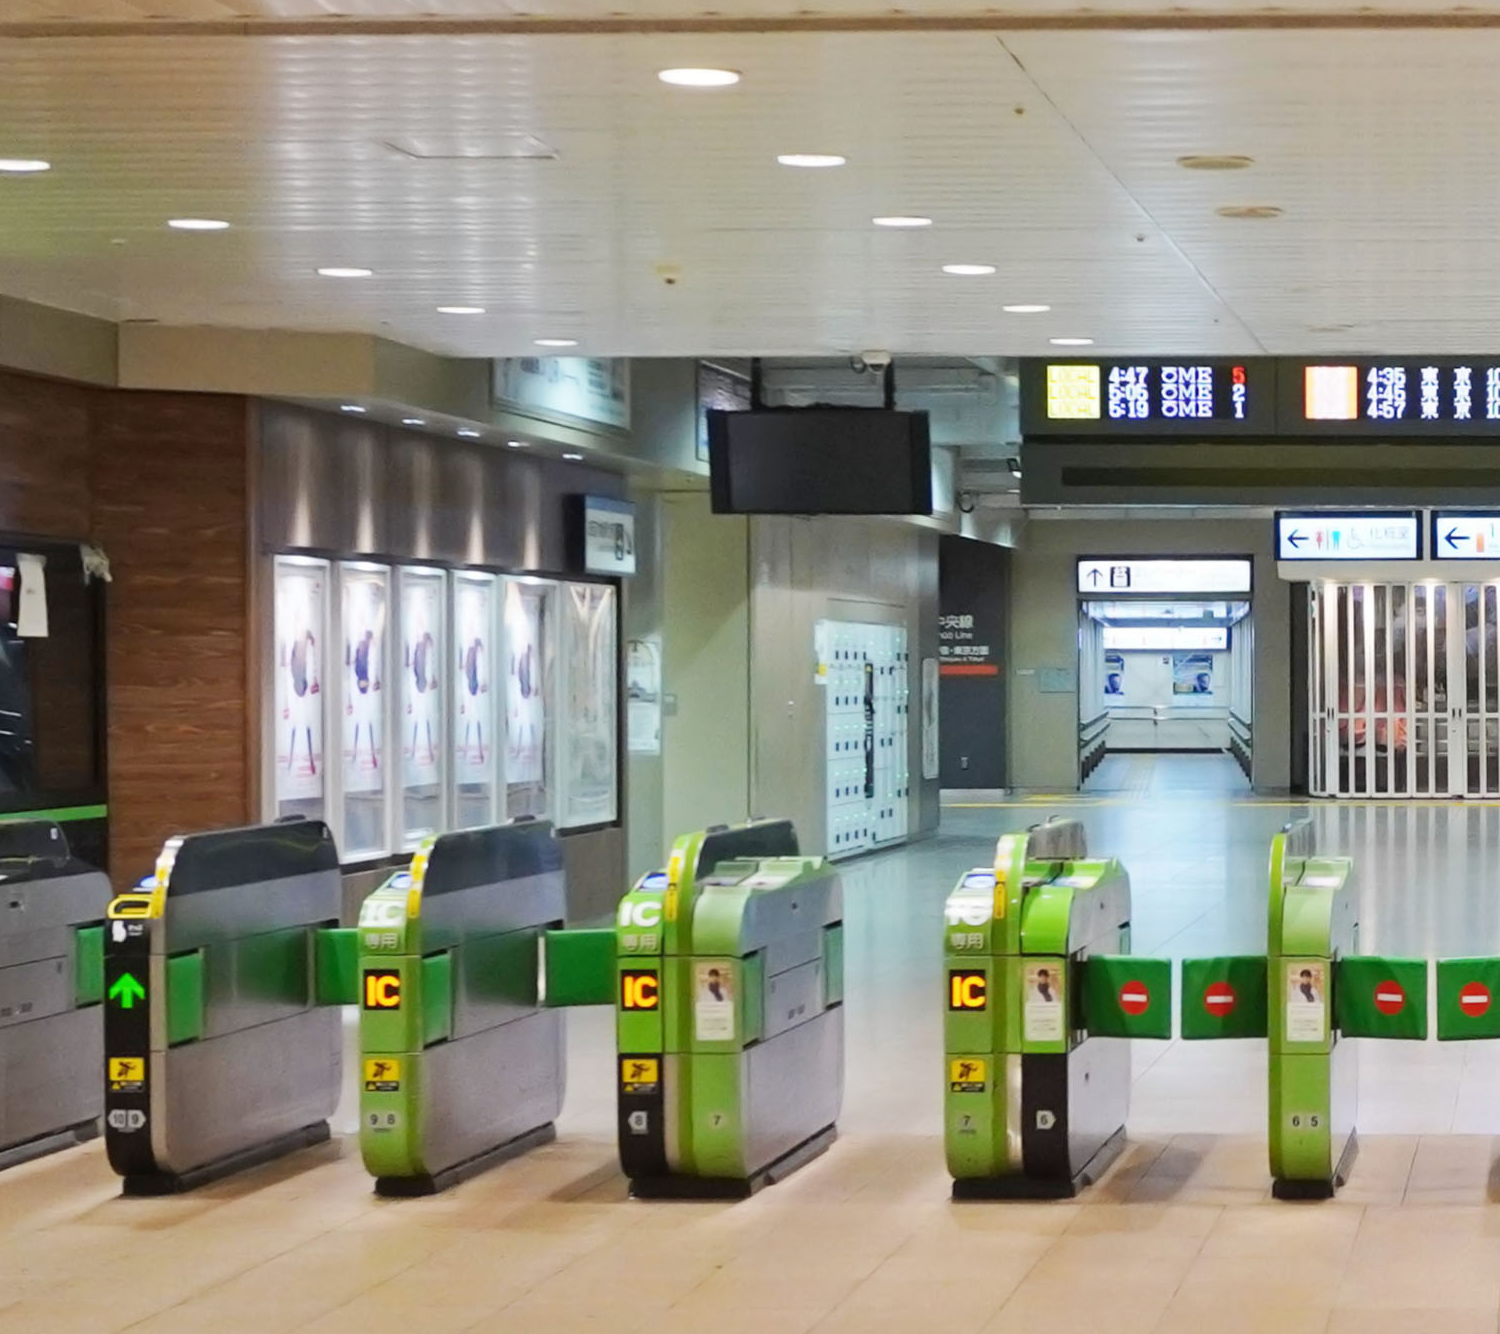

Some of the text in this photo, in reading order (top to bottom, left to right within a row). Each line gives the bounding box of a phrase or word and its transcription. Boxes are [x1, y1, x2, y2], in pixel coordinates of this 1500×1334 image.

[1108, 366, 1149, 384] 4:47
[1232, 366, 1246, 384] 5
[1367, 367, 1406, 384] 4:35
[1232, 384, 1246, 400] 2
[1367, 401, 1406, 418] 4:57
[620, 901, 662, 927] IC
[364, 930, 398, 949] 専用
[621, 932, 657, 952] 専用
[949, 932, 984, 952] 専用
[366, 975, 400, 1007] IC
[623, 975, 658, 1007] IC
[953, 975, 986, 1007] IC
[113, 1113, 124, 1125] 10
[131, 1113, 139, 1125] 9
[370, 1114, 377, 1125] 9
[713, 1114, 721, 1126] 7
[962, 1114, 970, 1126] 7
[1040, 1114, 1048, 1126] 6
[1291, 1115, 1300, 1127] 6
[1310, 1115, 1318, 1127] 5
